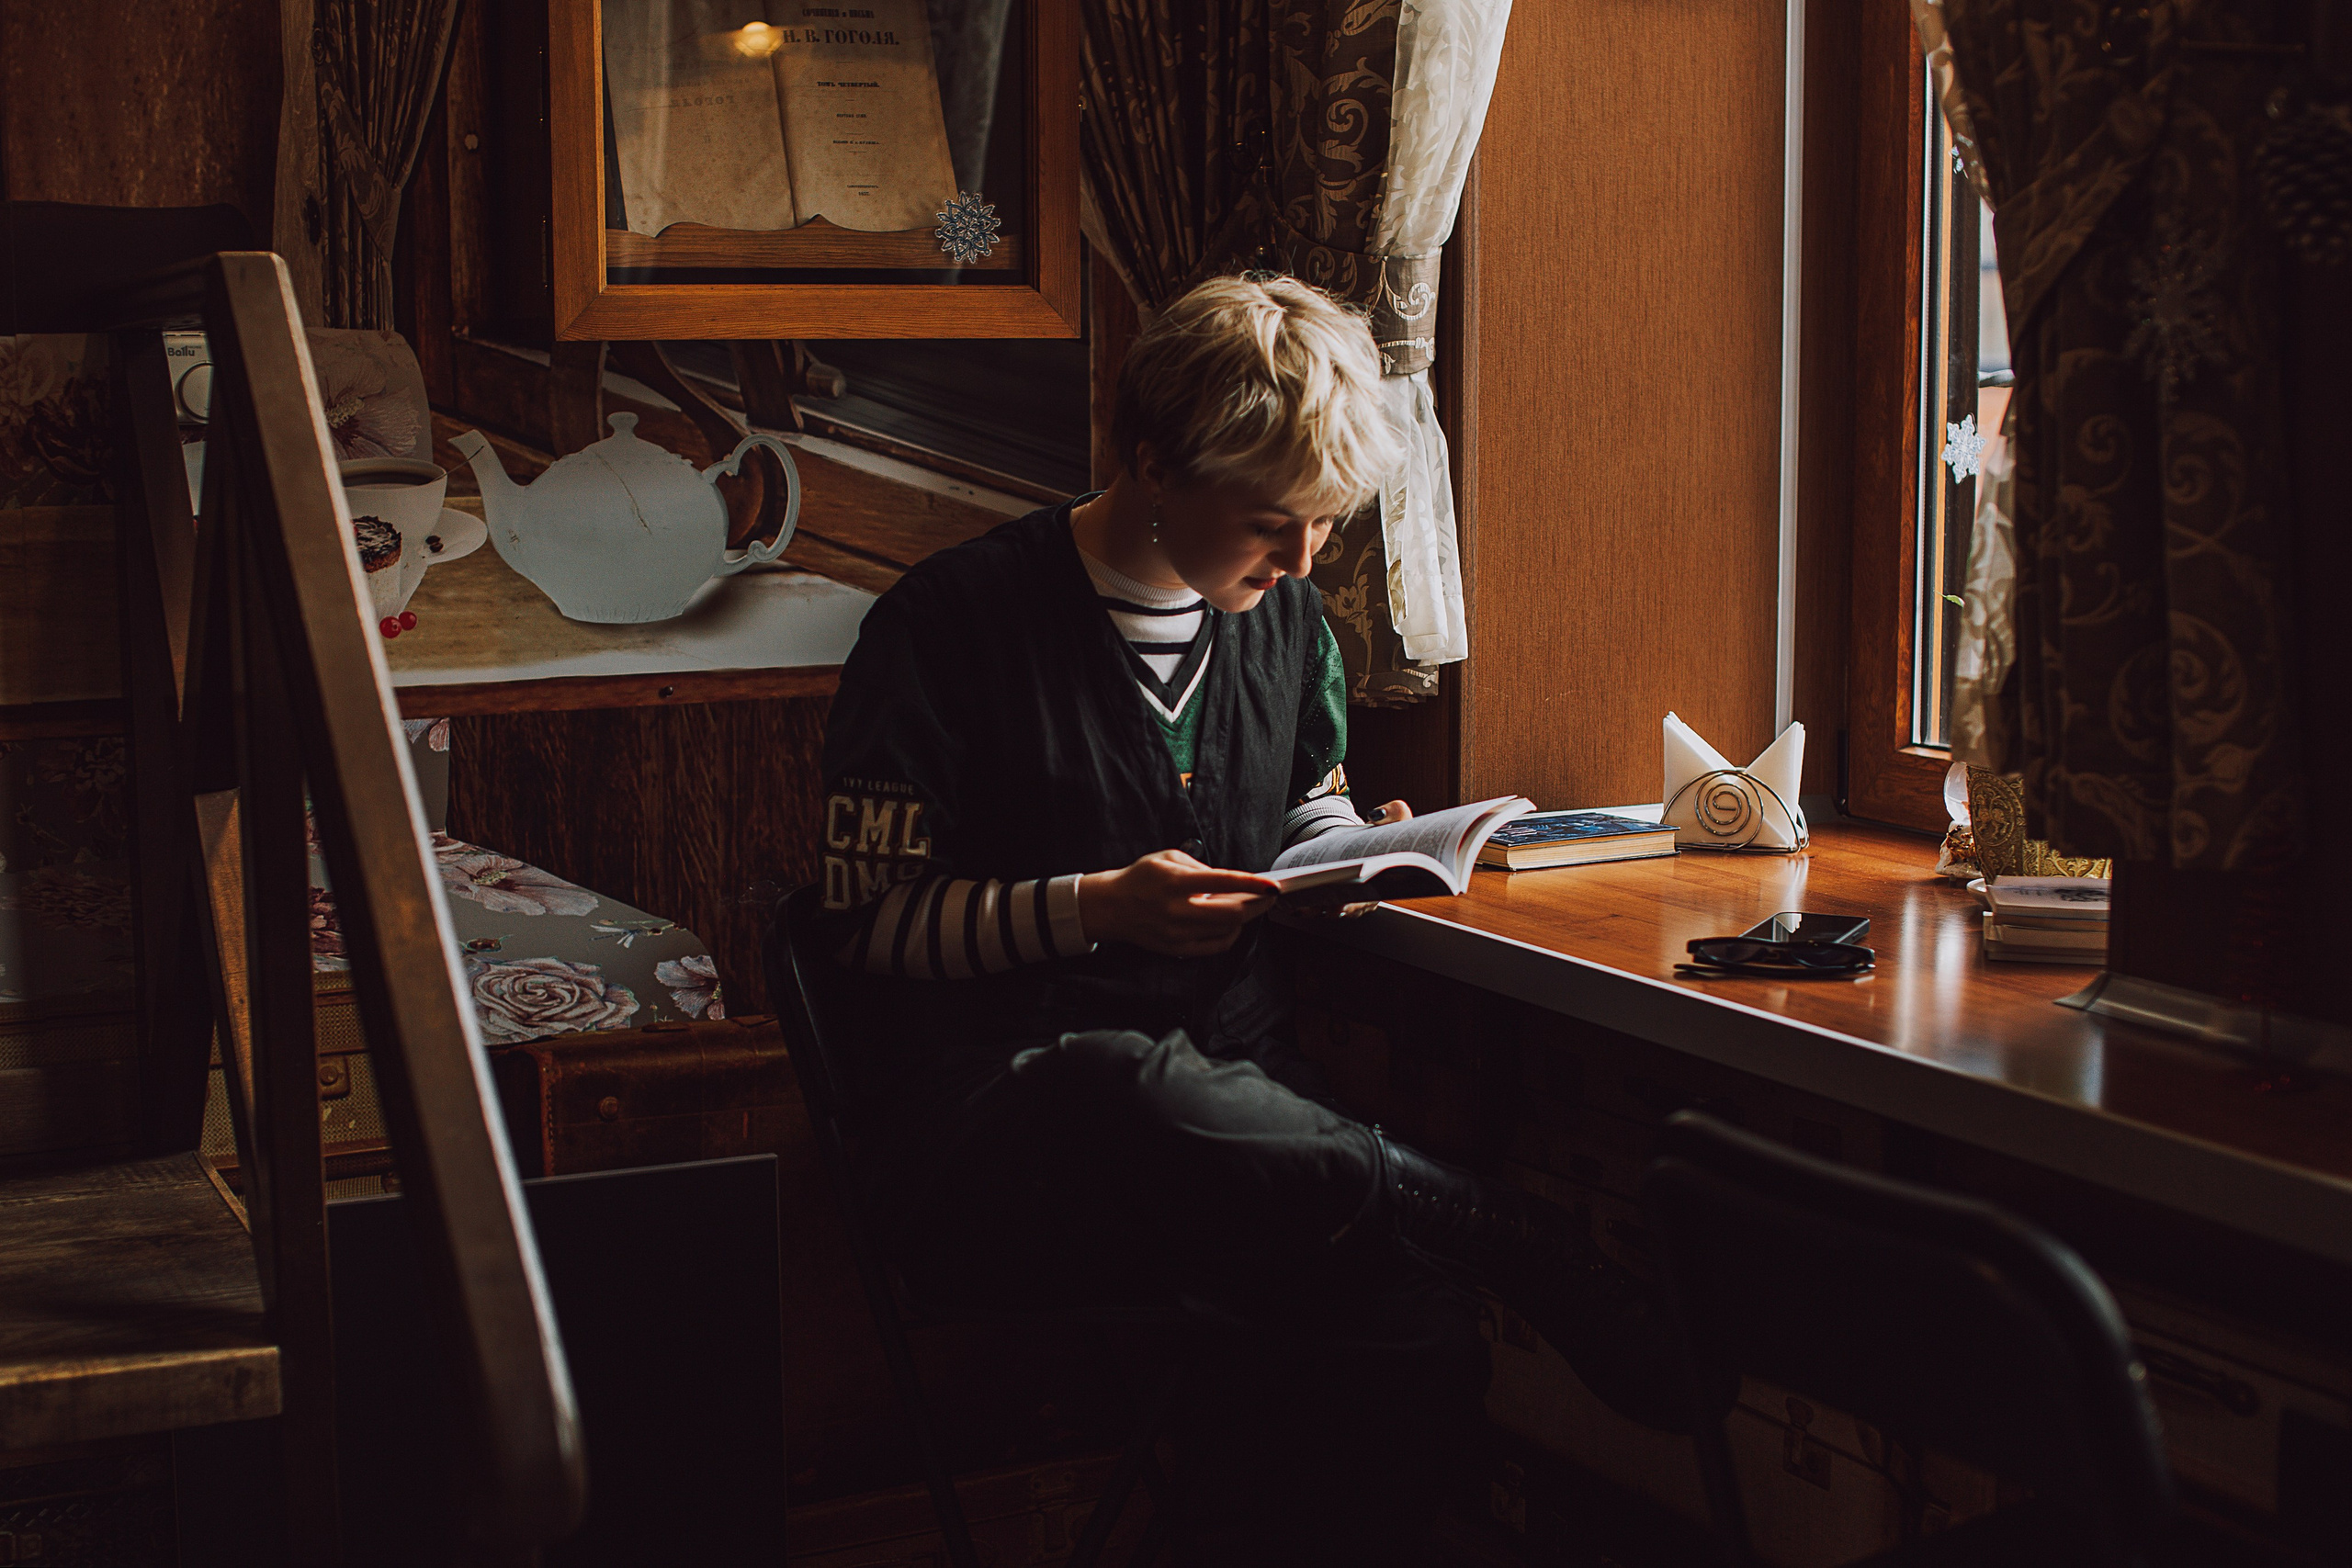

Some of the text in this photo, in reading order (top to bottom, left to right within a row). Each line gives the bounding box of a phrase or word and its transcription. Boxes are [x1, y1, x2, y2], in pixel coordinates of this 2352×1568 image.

[783, 29, 900, 45] Н. В. ГОГОЛЯ.
[867, 780, 915, 795] LEAGUE
[827, 794, 929, 857] CML
